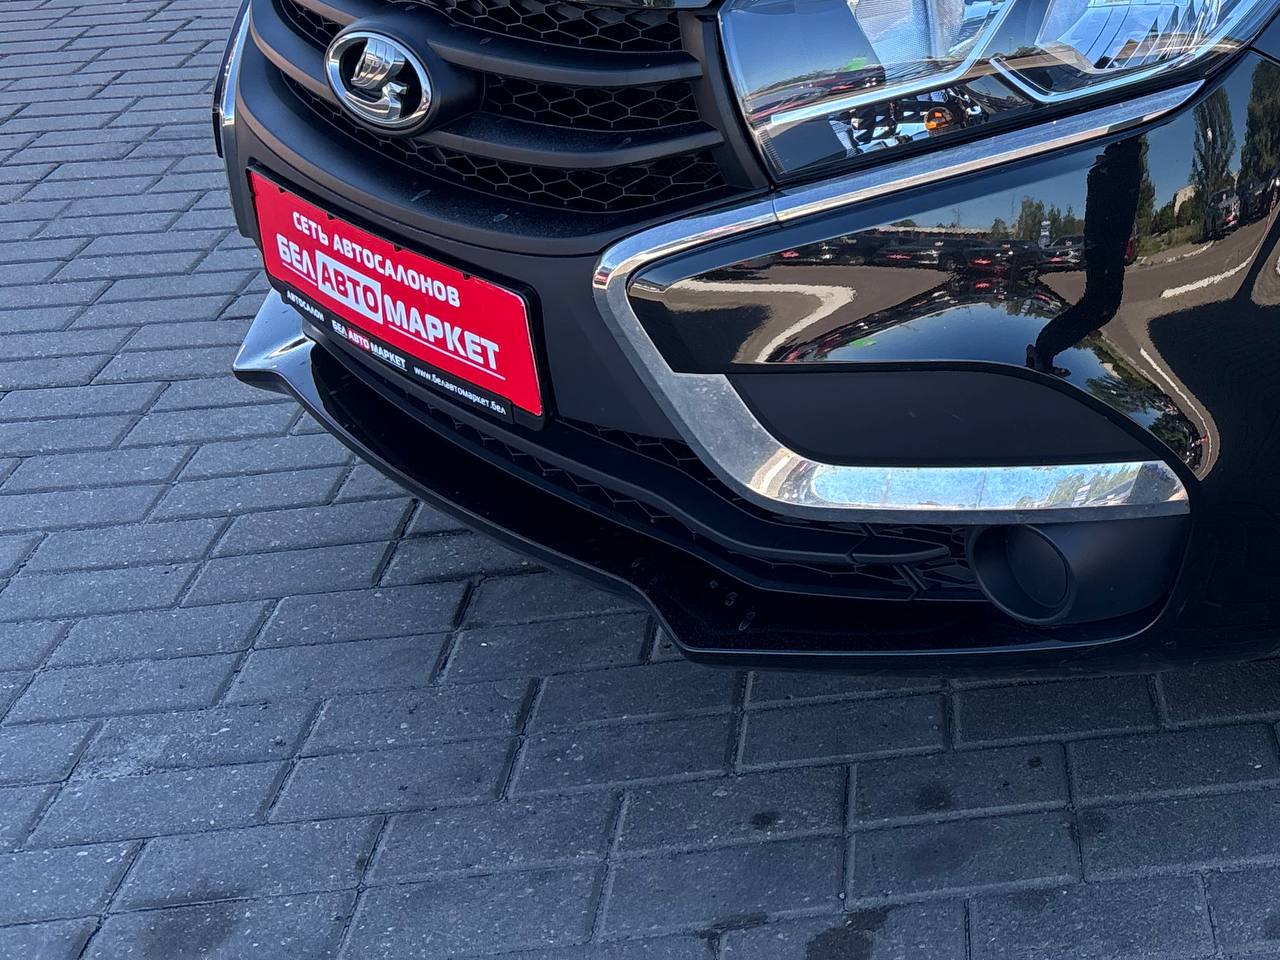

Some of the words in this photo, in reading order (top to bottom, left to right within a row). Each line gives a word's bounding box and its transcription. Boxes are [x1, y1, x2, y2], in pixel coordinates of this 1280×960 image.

[292, 211, 329, 246] СЕТЬ
[333, 234, 460, 308] АВТОСАЛОНОВ
[287, 290, 325, 322] АВТОСАЛОН
